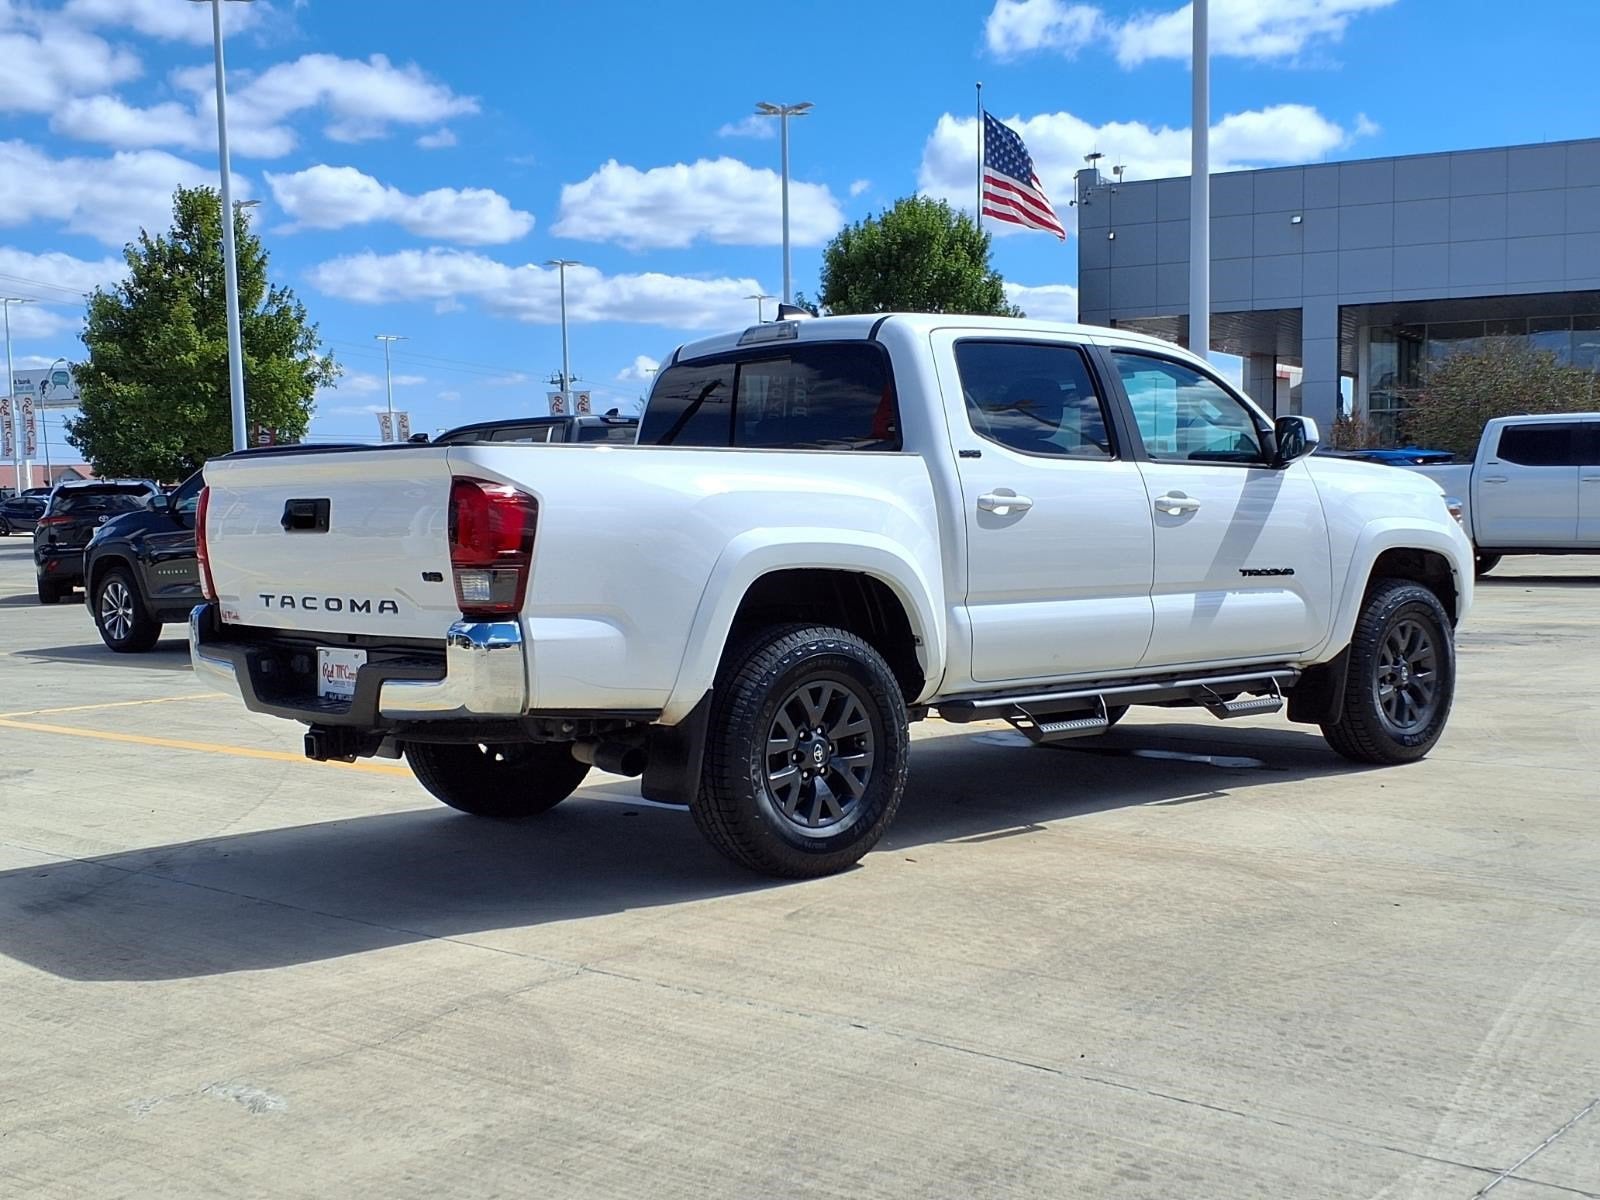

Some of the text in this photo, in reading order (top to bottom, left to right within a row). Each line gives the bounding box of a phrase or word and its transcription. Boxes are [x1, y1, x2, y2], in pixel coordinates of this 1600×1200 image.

[22, 397, 33, 415] Red
[259, 594, 399, 615] TACOMA
[322, 662, 335, 684] Red
